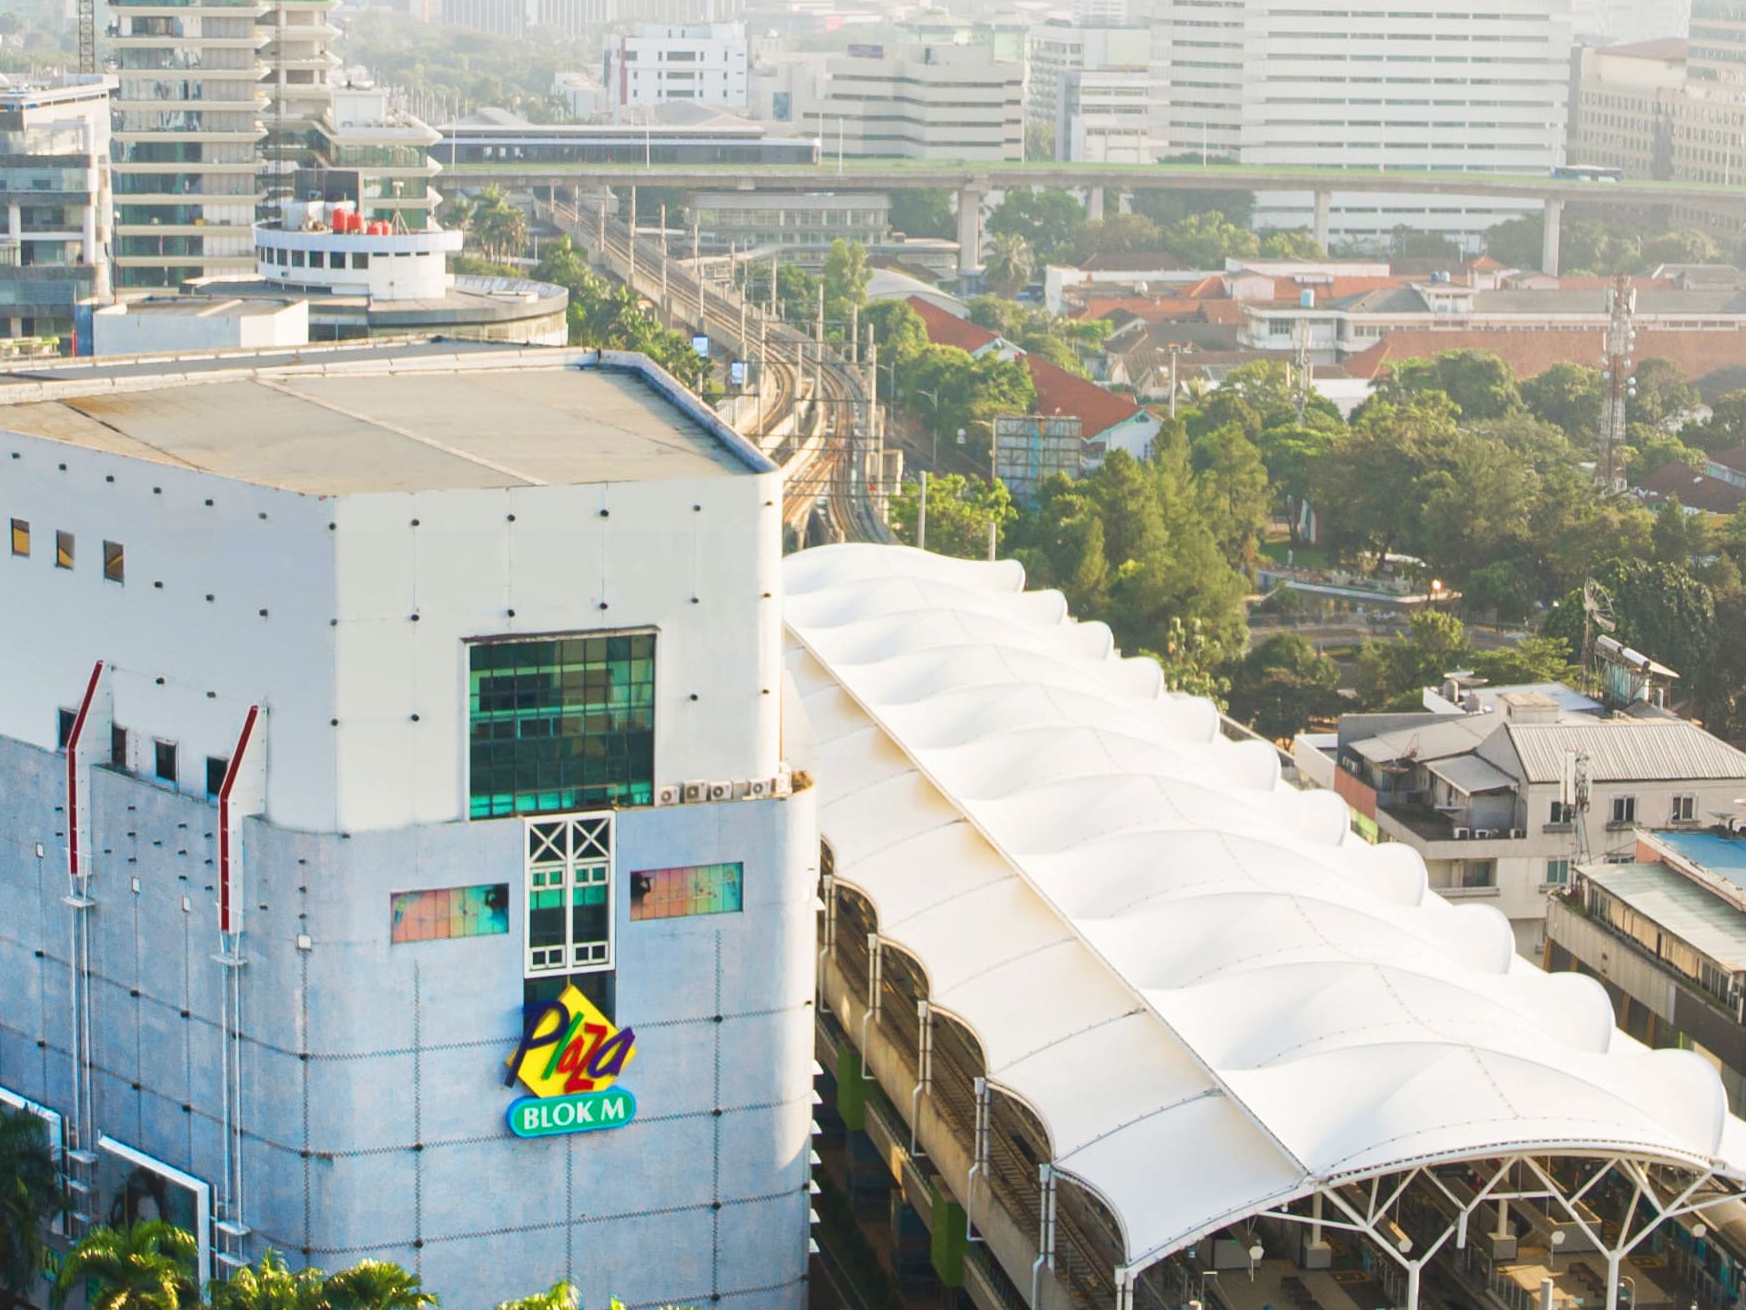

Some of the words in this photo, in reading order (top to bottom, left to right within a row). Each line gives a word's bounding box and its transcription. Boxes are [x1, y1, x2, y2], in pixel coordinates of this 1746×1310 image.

[504, 999, 636, 1094] Plaza
[523, 1101, 594, 1129] BLOK
[600, 1097, 625, 1121] M
